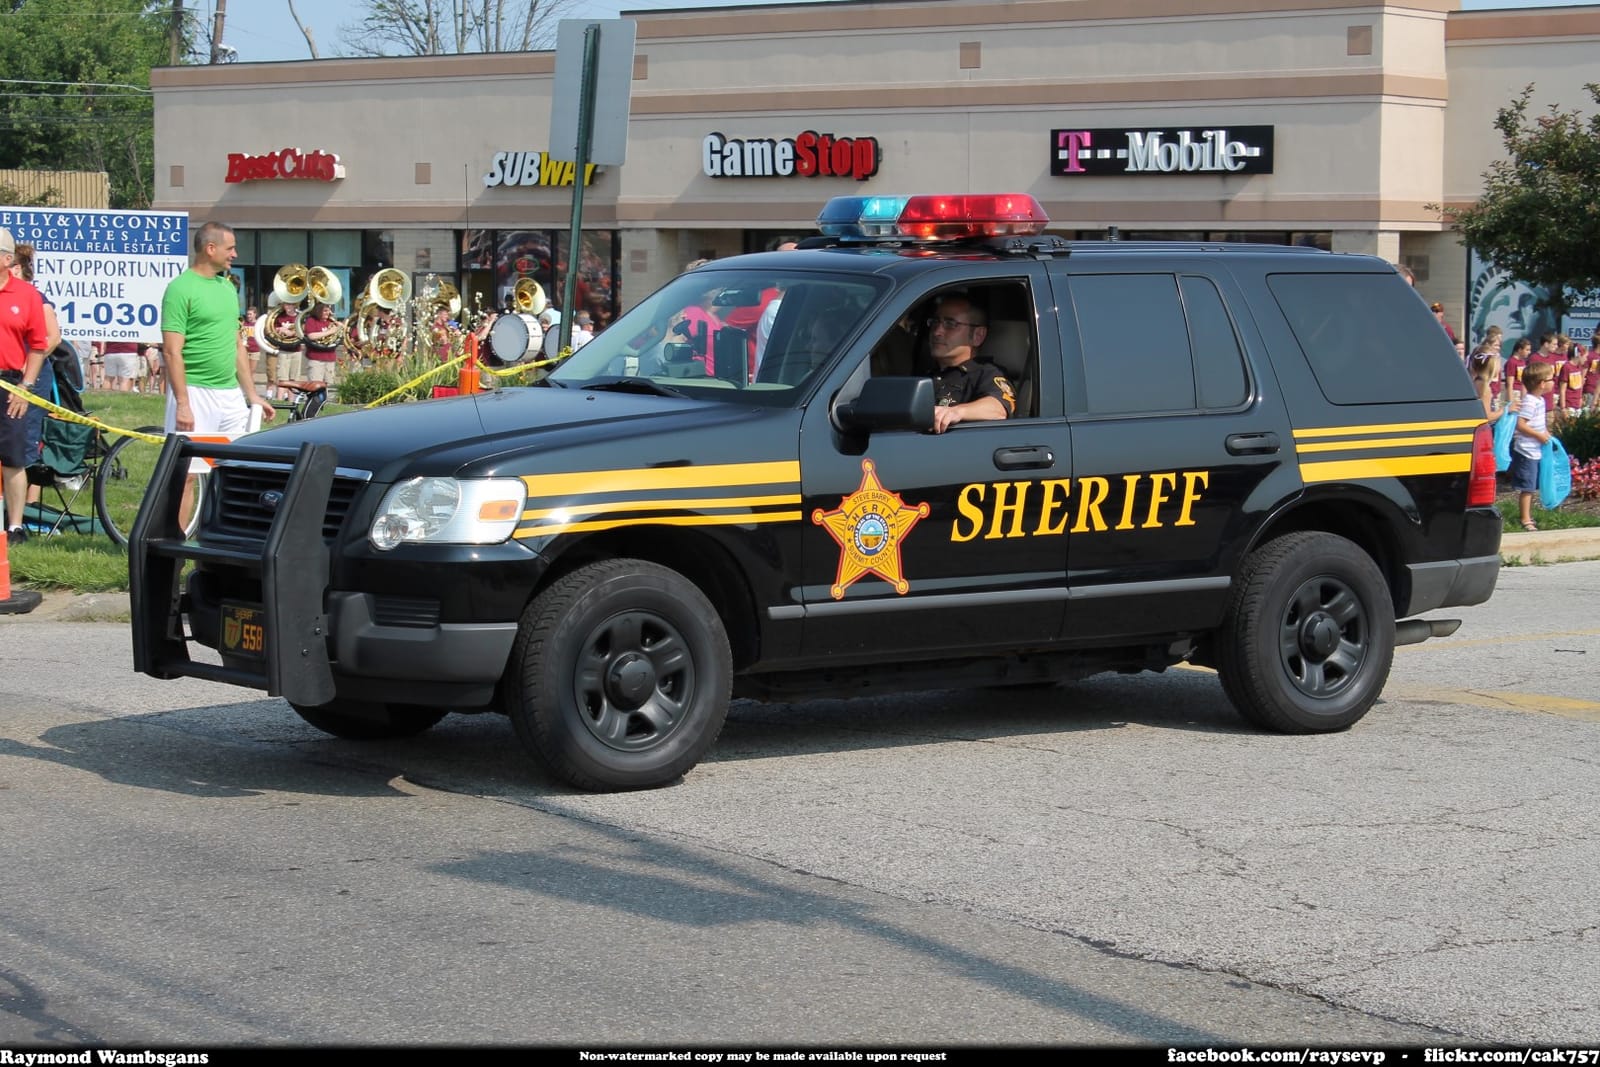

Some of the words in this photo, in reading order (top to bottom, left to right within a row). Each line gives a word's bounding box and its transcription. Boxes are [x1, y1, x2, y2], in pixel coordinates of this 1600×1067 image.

[703, 131, 878, 180] GameStop
[86, 242, 117, 252] REAL
[124, 243, 170, 254] ESTATE
[32, 258, 65, 275] ENT
[70, 259, 185, 278] OPPORTUNITY
[44, 280, 125, 298] AVAILABLE
[51, 301, 158, 327] 1-030
[847, 503, 896, 532] SHERIFF
[950, 470, 1209, 542] SHERIFF
